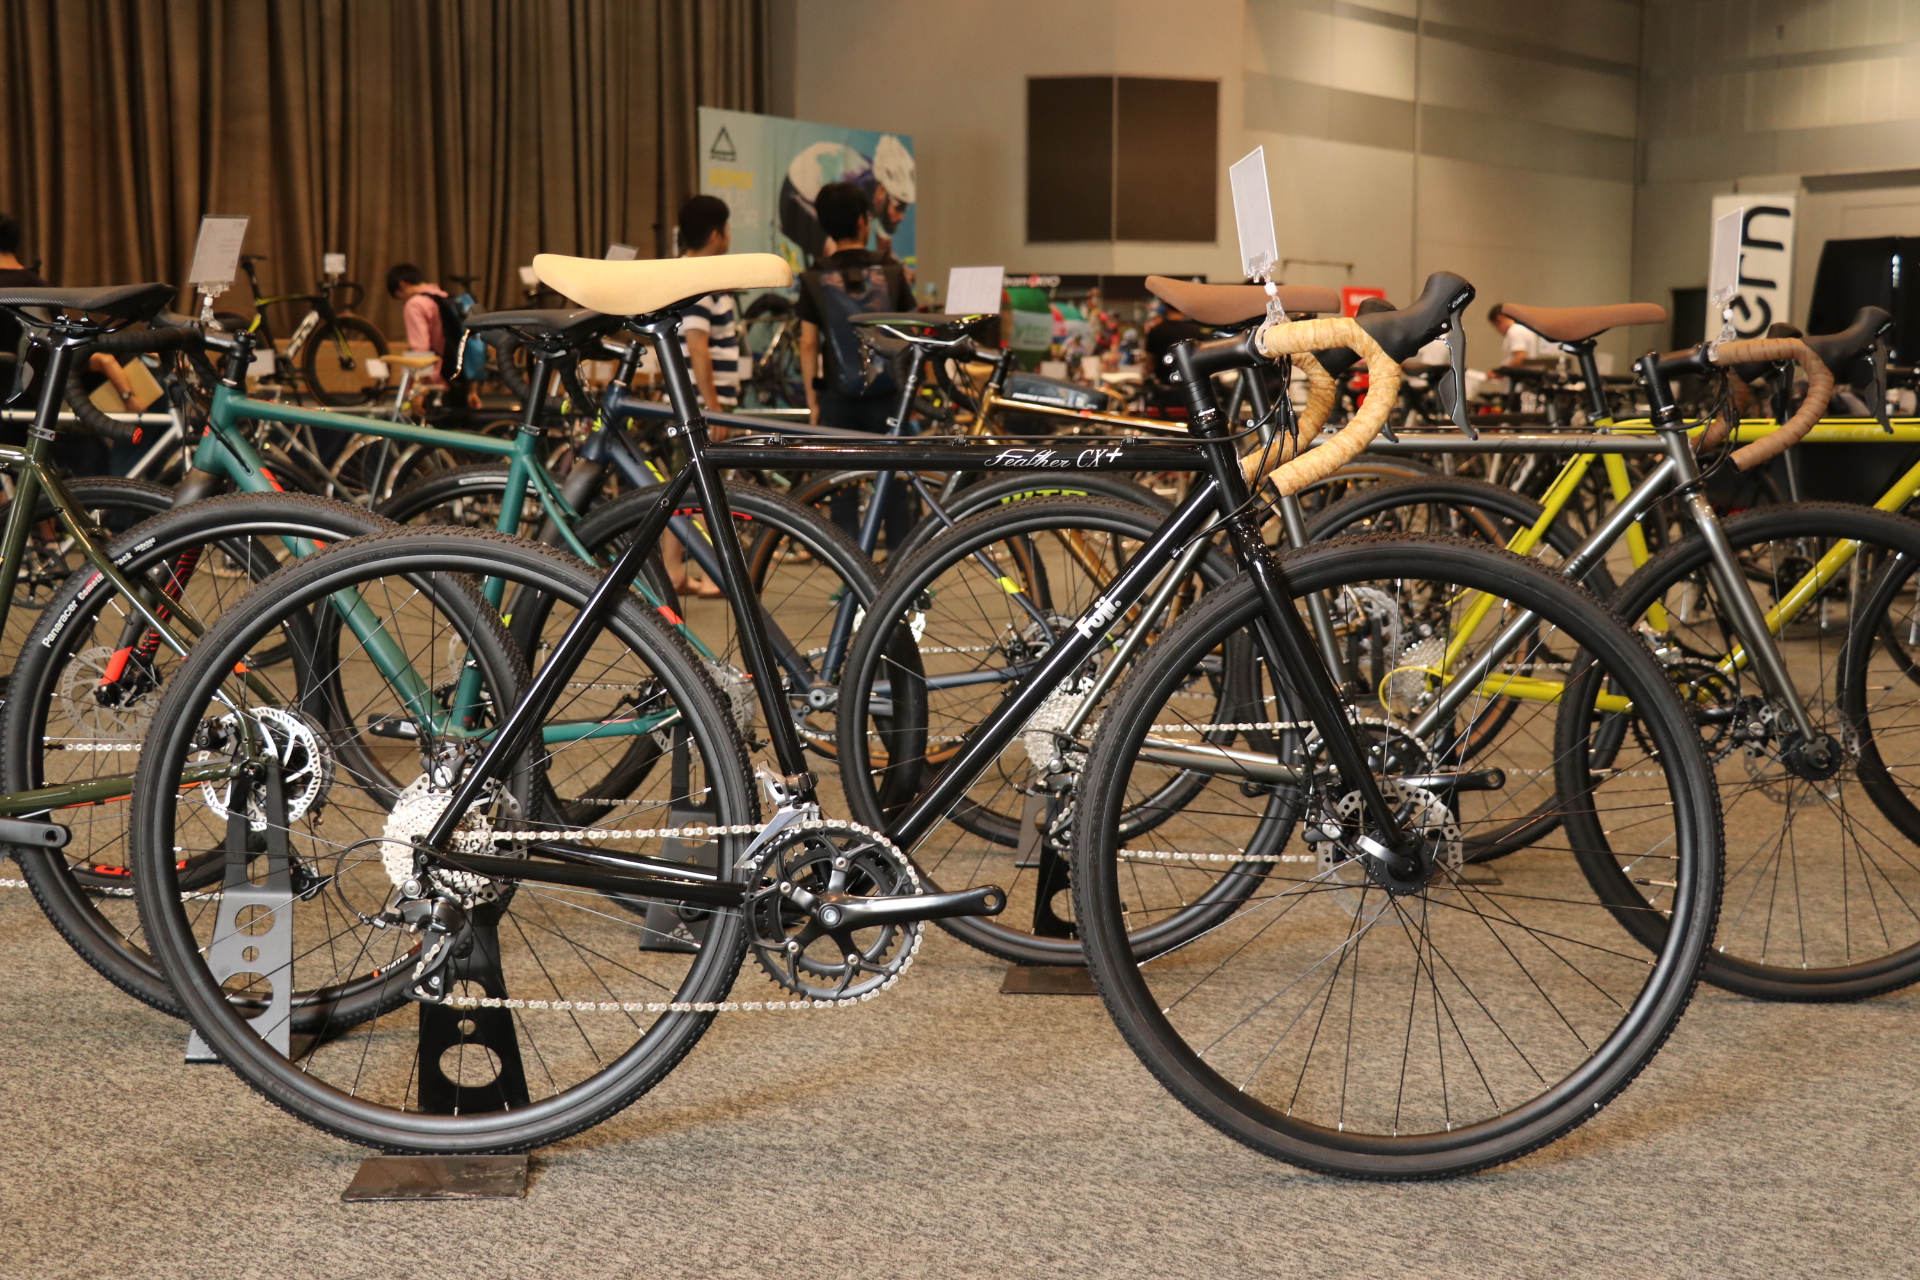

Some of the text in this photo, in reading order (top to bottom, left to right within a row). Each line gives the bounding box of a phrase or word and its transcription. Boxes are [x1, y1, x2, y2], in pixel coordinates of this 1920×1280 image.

[984, 447, 1123, 467] Feather CX+
[42, 600, 78, 648] Panaracer
